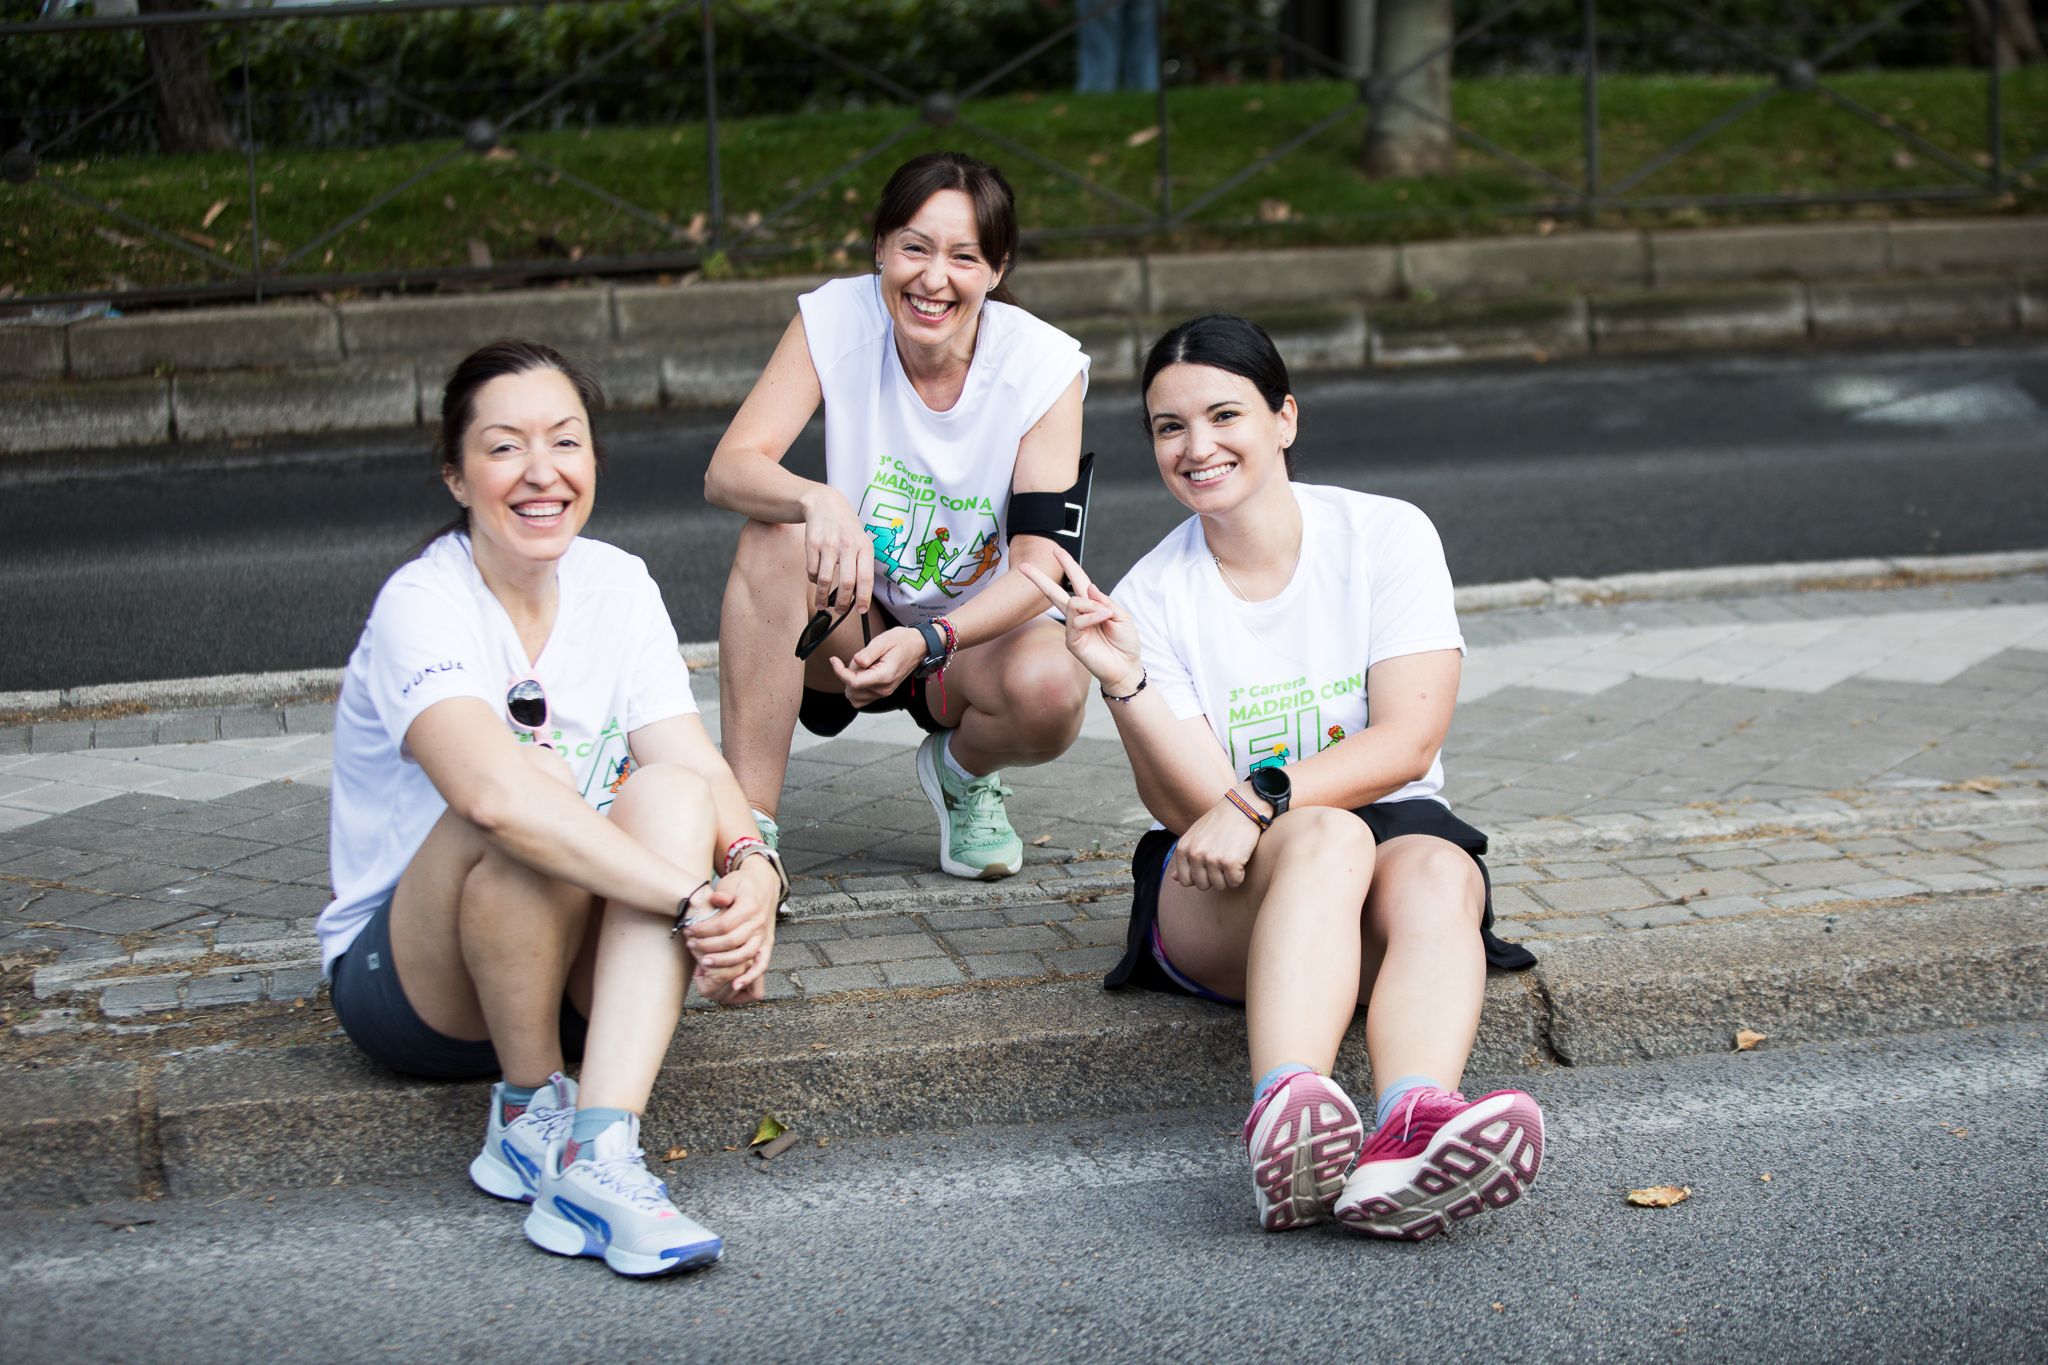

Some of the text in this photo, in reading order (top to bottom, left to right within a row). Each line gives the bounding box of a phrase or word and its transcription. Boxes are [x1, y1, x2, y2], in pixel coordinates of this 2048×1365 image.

[894, 460, 933, 485] Crera
[873, 470, 992, 511] MADRID CON A
[1229, 673, 1362, 723] MADRID CON
[1249, 677, 1306, 698] Carrera
